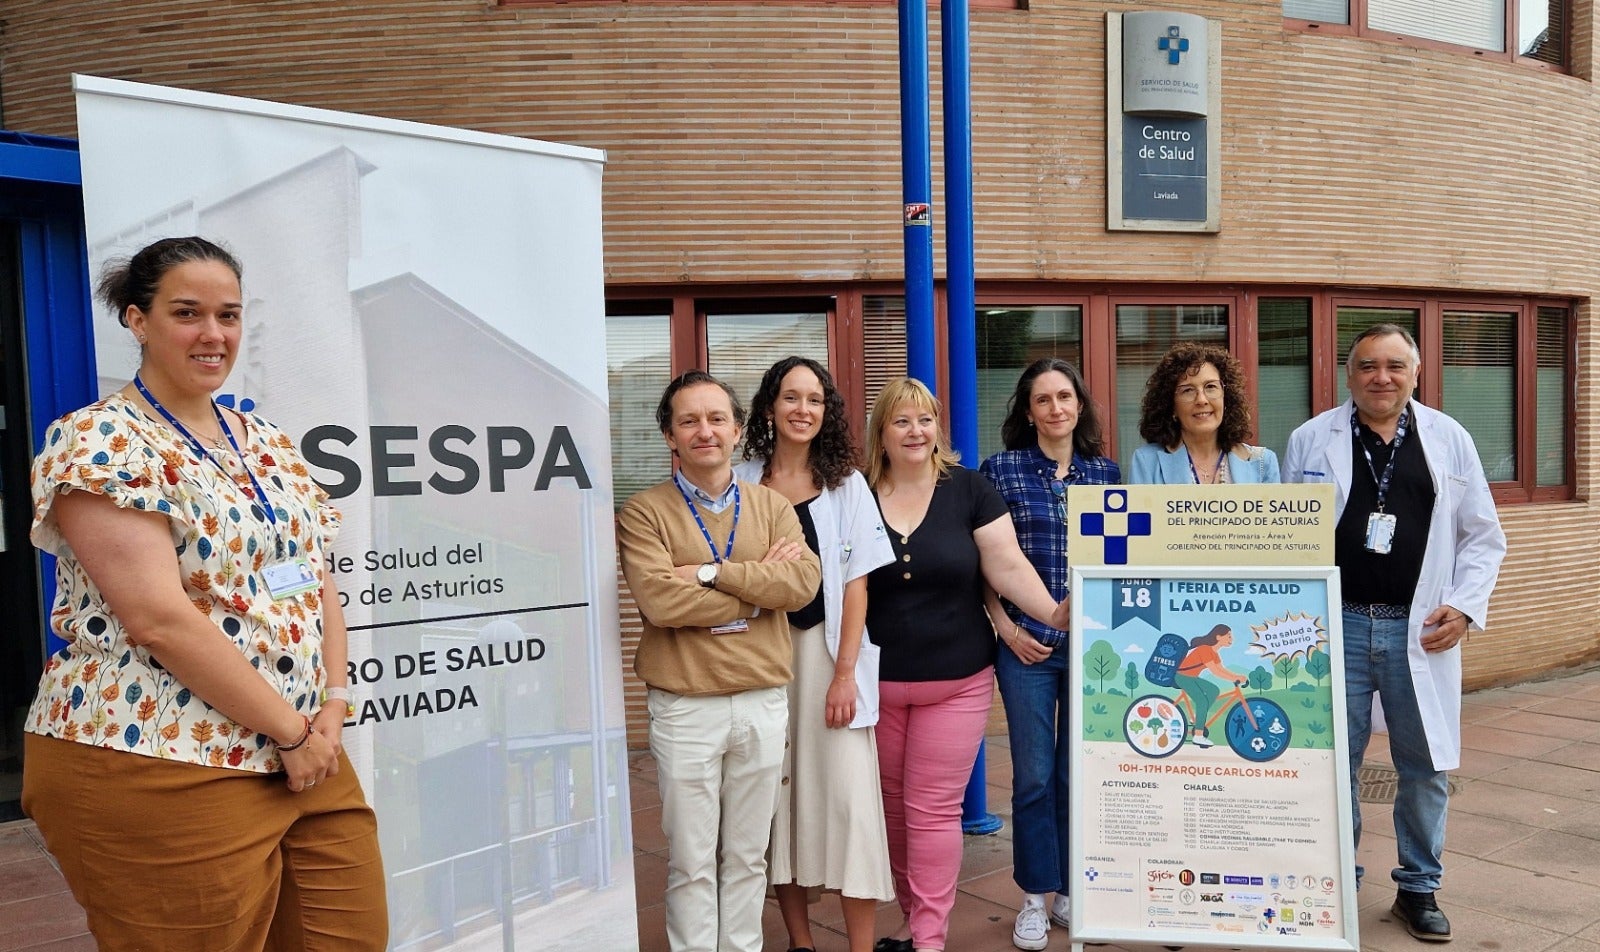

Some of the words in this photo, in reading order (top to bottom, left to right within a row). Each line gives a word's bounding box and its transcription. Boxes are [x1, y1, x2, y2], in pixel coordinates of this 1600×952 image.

[1142, 125, 1191, 142] Centro
[1138, 145, 1155, 159] de
[1159, 146, 1195, 161] Salud
[1153, 190, 1179, 200] Laviada
[300, 424, 593, 500] SESPA
[1166, 500, 1238, 514] SERVICIO
[1243, 500, 1264, 514] DE
[1269, 499, 1322, 514] SALUD
[1167, 517, 1186, 526] DEL
[1189, 517, 1253, 526] PRINCIPADO
[1255, 517, 1269, 526] DE
[1271, 516, 1320, 526] ASTURIAS
[1193, 532, 1227, 540] Atención
[1267, 531, 1286, 540] Área
[1166, 543, 1207, 551] GOBIERNO
[1208, 543, 1222, 551] DEL
[1224, 543, 1271, 551] PRINCIPADO
[1272, 543, 1283, 551] DE
[1284, 543, 1321, 551] ASTURIAS
[364, 545, 437, 573] Salud
[446, 542, 483, 565] del
[360, 583, 393, 606] de
[402, 574, 505, 602] Asturias
[1177, 582, 1221, 595] FERIA
[1225, 582, 1245, 595] DE
[1249, 583, 1301, 595] SALUD
[1121, 587, 1152, 608] 18
[1169, 599, 1257, 613] LAVIADA
[1265, 633, 1278, 641] Da
[1280, 626, 1305, 639] salud
[1282, 635, 1311, 646] barrio
[394, 650, 437, 679] DE
[445, 637, 547, 672] SALUD
[1153, 656, 1176, 667] STRESS
[1118, 763, 1162, 774] 10H-17H
[1165, 765, 1213, 777] PARQUE
[1214, 766, 1262, 778] CARLOS
[1264, 768, 1299, 779] MARX
[1102, 780, 1159, 789] ACTIVIDADES:
[1183, 783, 1225, 792] CHARLAS:
